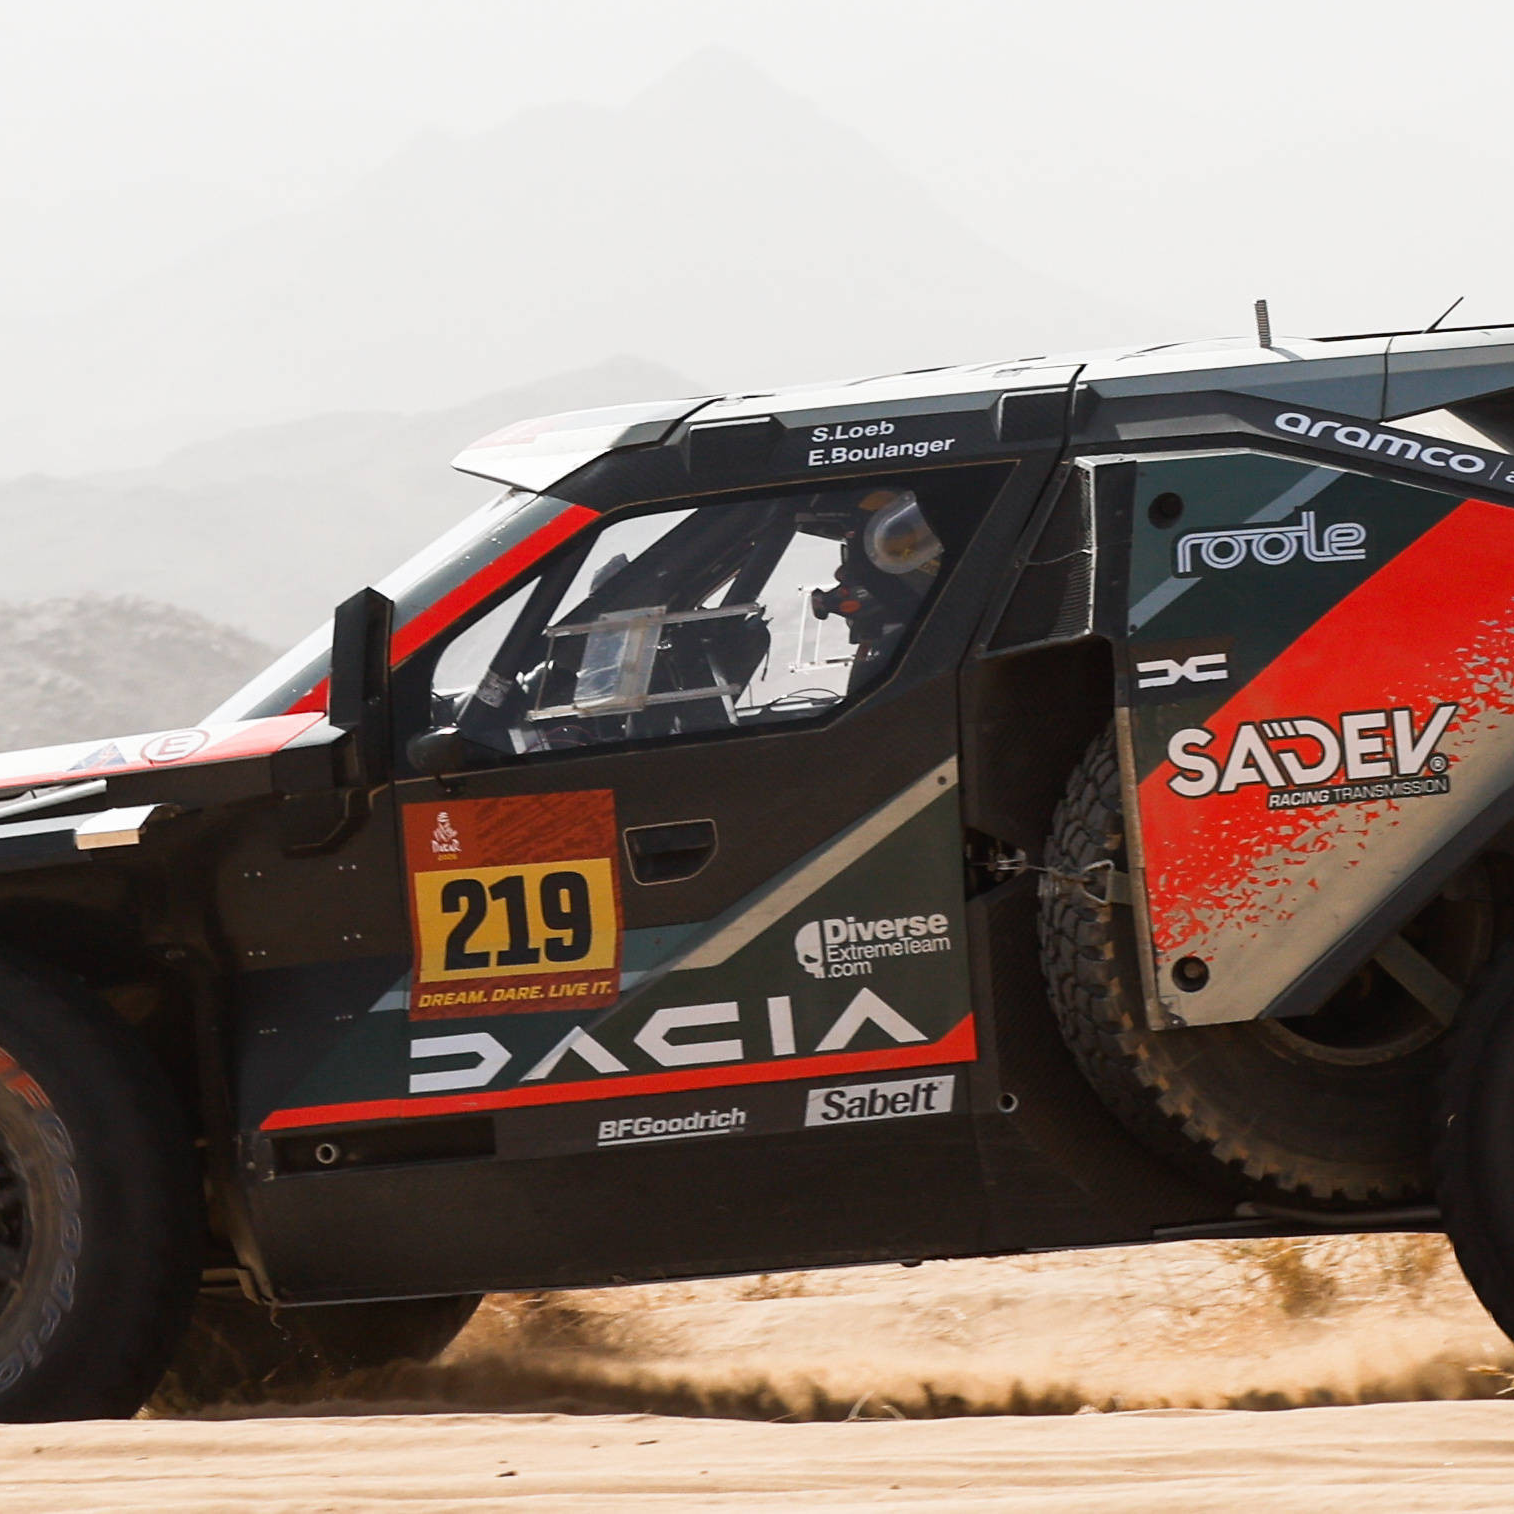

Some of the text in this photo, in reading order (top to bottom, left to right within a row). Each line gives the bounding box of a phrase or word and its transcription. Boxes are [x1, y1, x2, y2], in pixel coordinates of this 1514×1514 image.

[811, 421, 895, 443] S.Loeb
[1274, 412, 1486, 474] aramco
[808, 438, 955, 466] E.Boulanger
[1268, 779, 1448, 808] RACING TRANSMISSION
[441, 871, 592, 971] 219
[823, 913, 949, 944] Diverse
[826, 937, 951, 963] ExtremeTeam
[828, 961, 872, 979] .com
[418, 981, 612, 1008] DREAM. DARE. LIVE IT.
[409, 987, 929, 1094] DACIA
[820, 1081, 938, 1121] Sabelt
[598, 1107, 746, 1140] BFGoodrich
